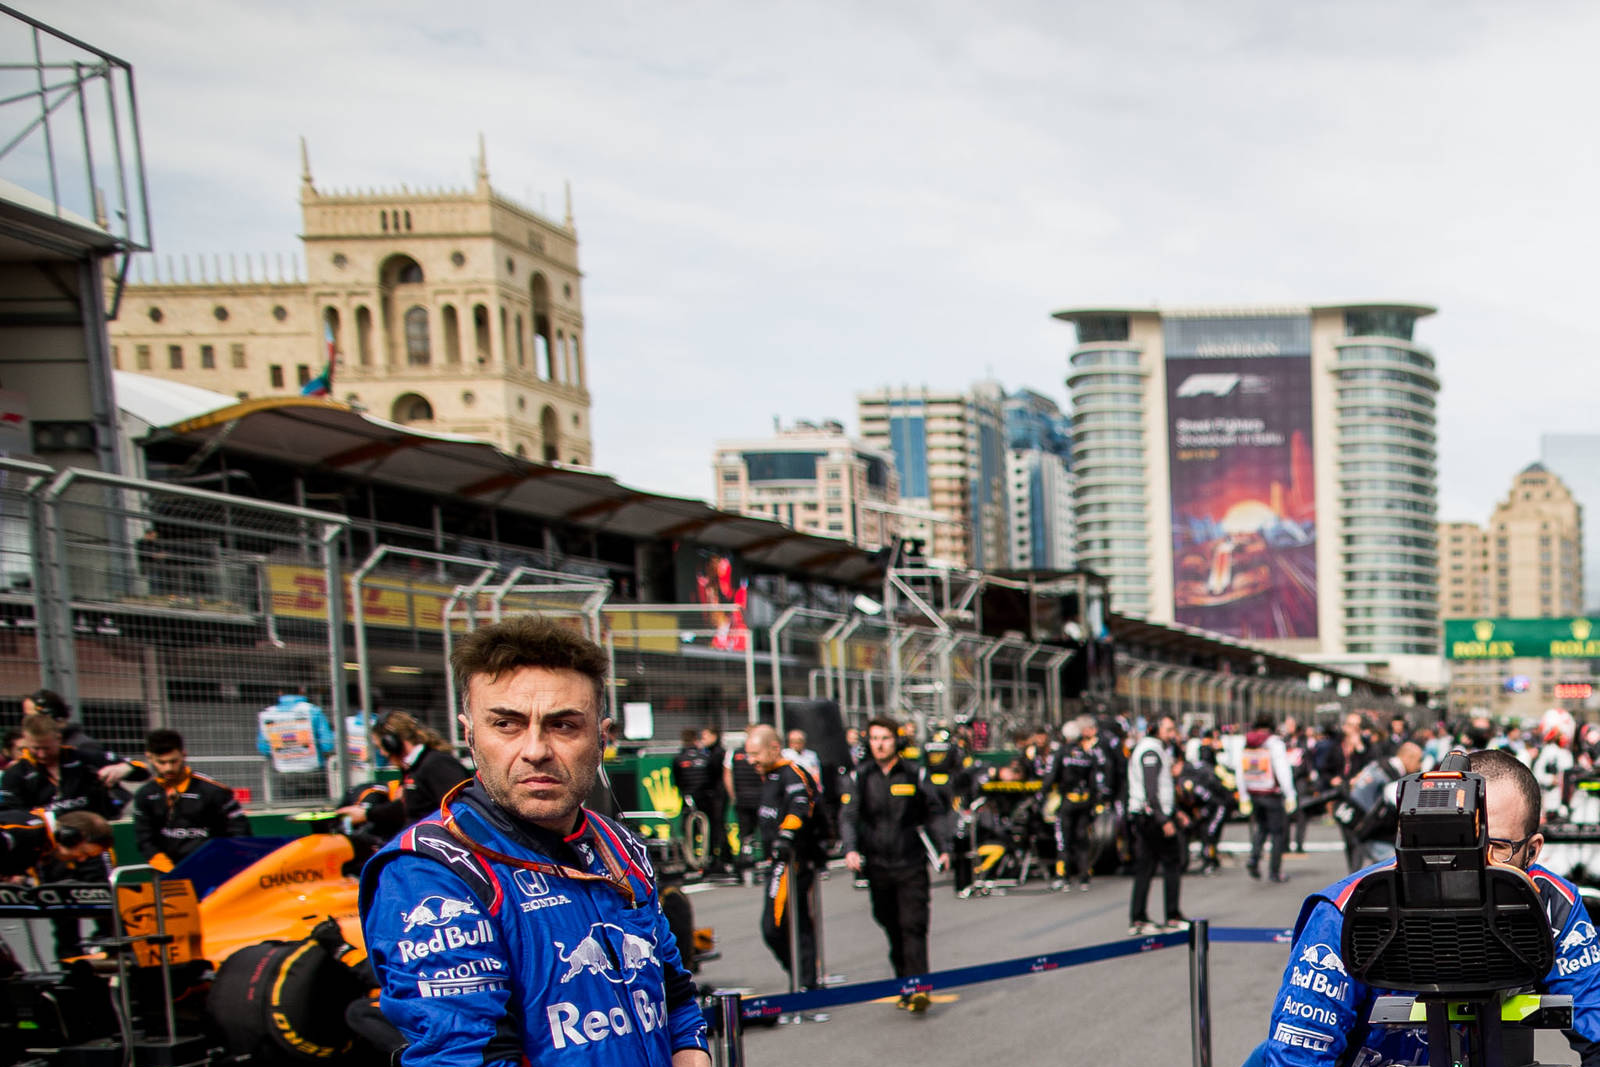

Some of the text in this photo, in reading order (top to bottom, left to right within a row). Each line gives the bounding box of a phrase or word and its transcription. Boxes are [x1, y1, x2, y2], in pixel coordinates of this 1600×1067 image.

[1453, 641, 1515, 657] ROLEX
[260, 870, 324, 889] CHANDON
[520, 894, 571, 913] HONDA
[398, 920, 494, 964] Red Bull
[1556, 947, 1592, 977] Red
[1290, 966, 1350, 1001] Red Bull
[547, 982, 668, 1049] Red Bu
[1282, 997, 1338, 1026] Acronis
[1273, 1023, 1336, 1053] PIRELLI
